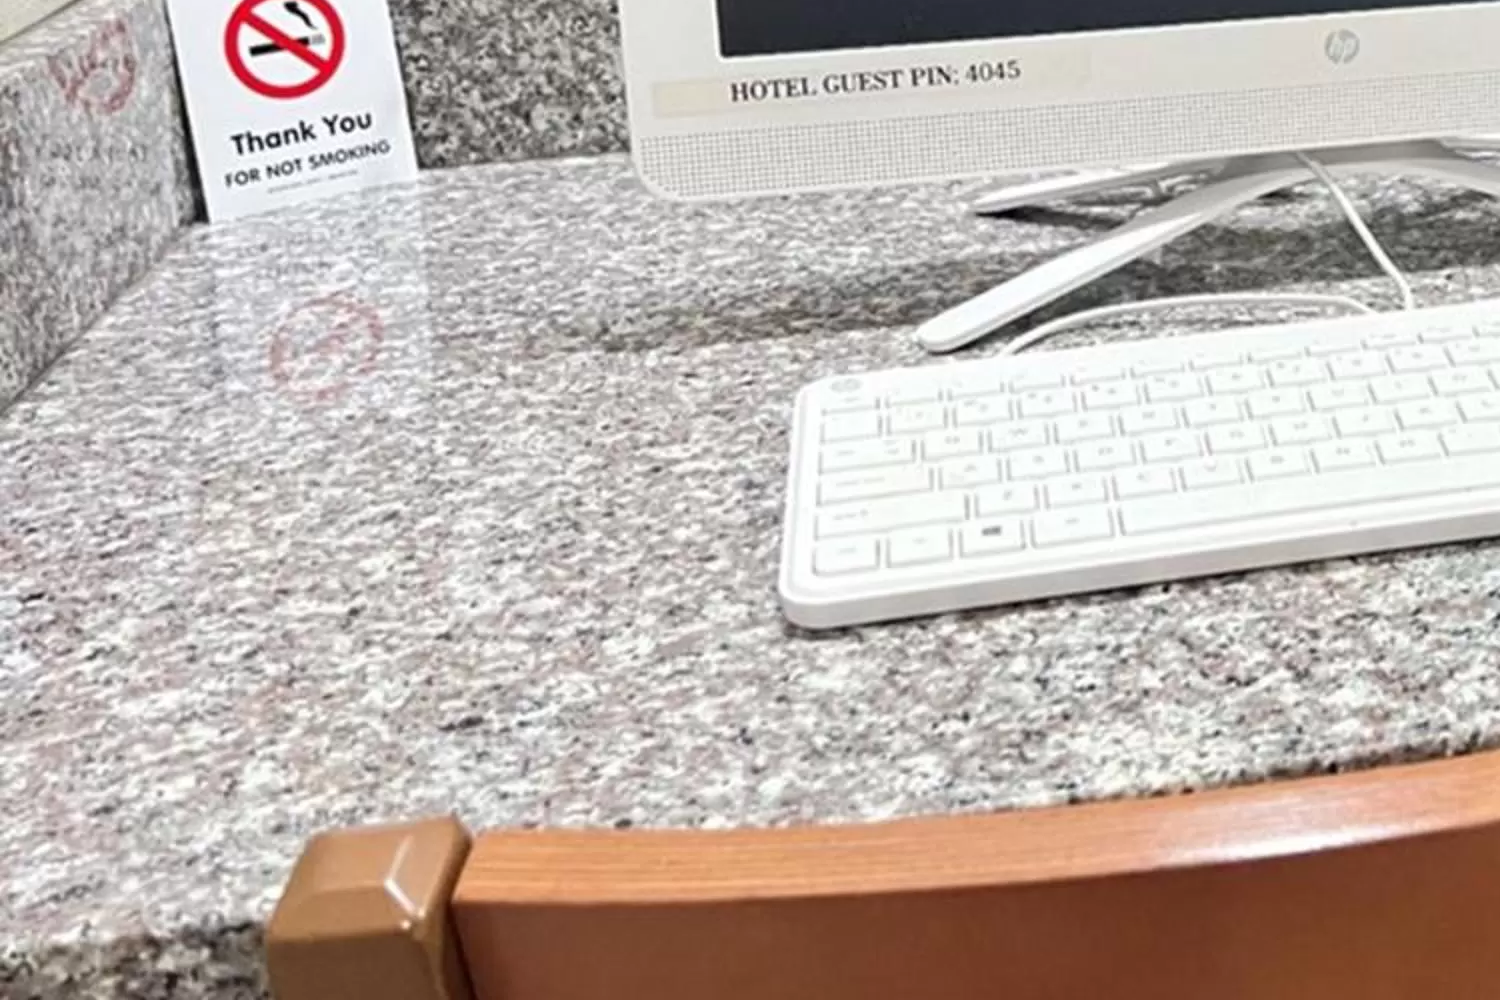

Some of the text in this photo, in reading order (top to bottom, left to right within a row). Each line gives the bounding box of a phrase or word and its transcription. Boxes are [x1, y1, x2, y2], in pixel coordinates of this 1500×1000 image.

[730, 76, 817, 103] HOTEL
[822, 69, 904, 95] GUEST
[965, 58, 1022, 82] 4045
[230, 112, 372, 156] Thank You
[224, 168, 261, 188] FOR
[266, 158, 303, 180] NOT
[308, 139, 391, 169] SMOKING
